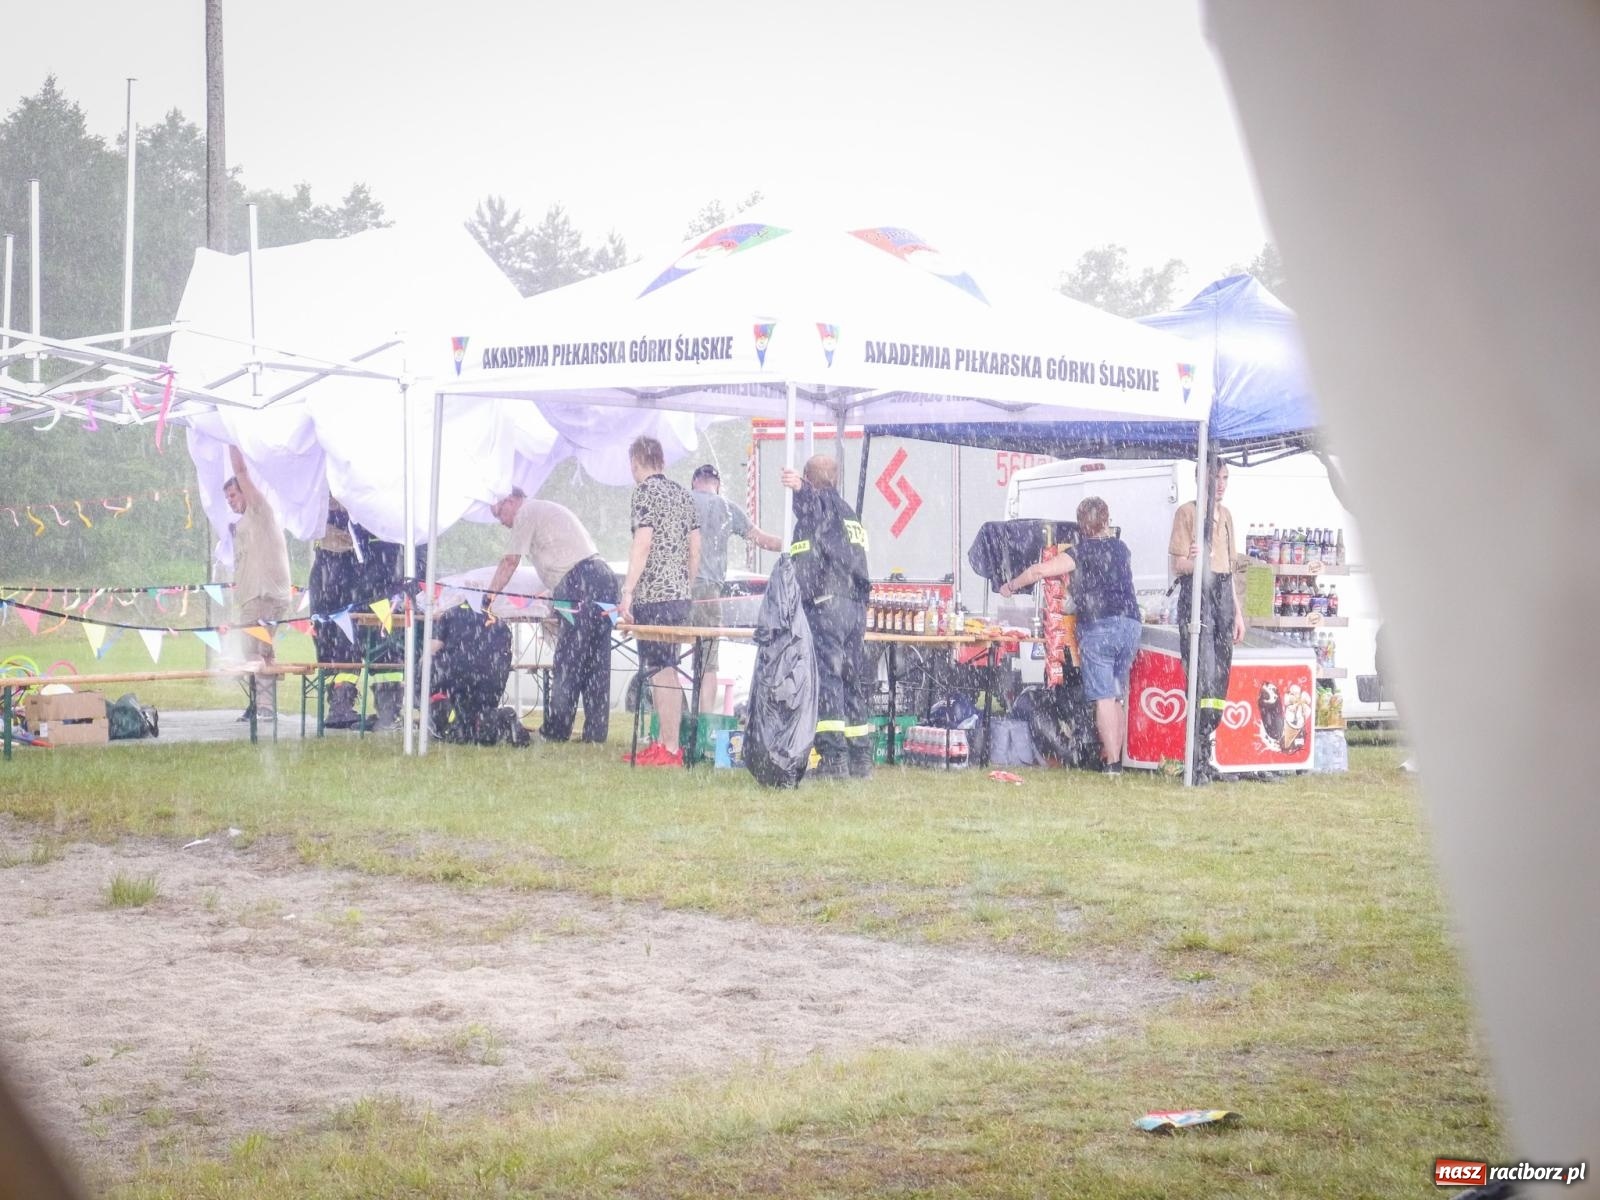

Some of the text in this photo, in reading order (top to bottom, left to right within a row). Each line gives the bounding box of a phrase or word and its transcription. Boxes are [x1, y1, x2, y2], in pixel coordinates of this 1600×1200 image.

[482, 334, 733, 369] AKADEMIA PIŁKARSKA GÓRKI ŚLĄSKIE
[864, 339, 1160, 392] AKADEMIA PIŁKARSKA GÓRKI ŚLĄSKIE
